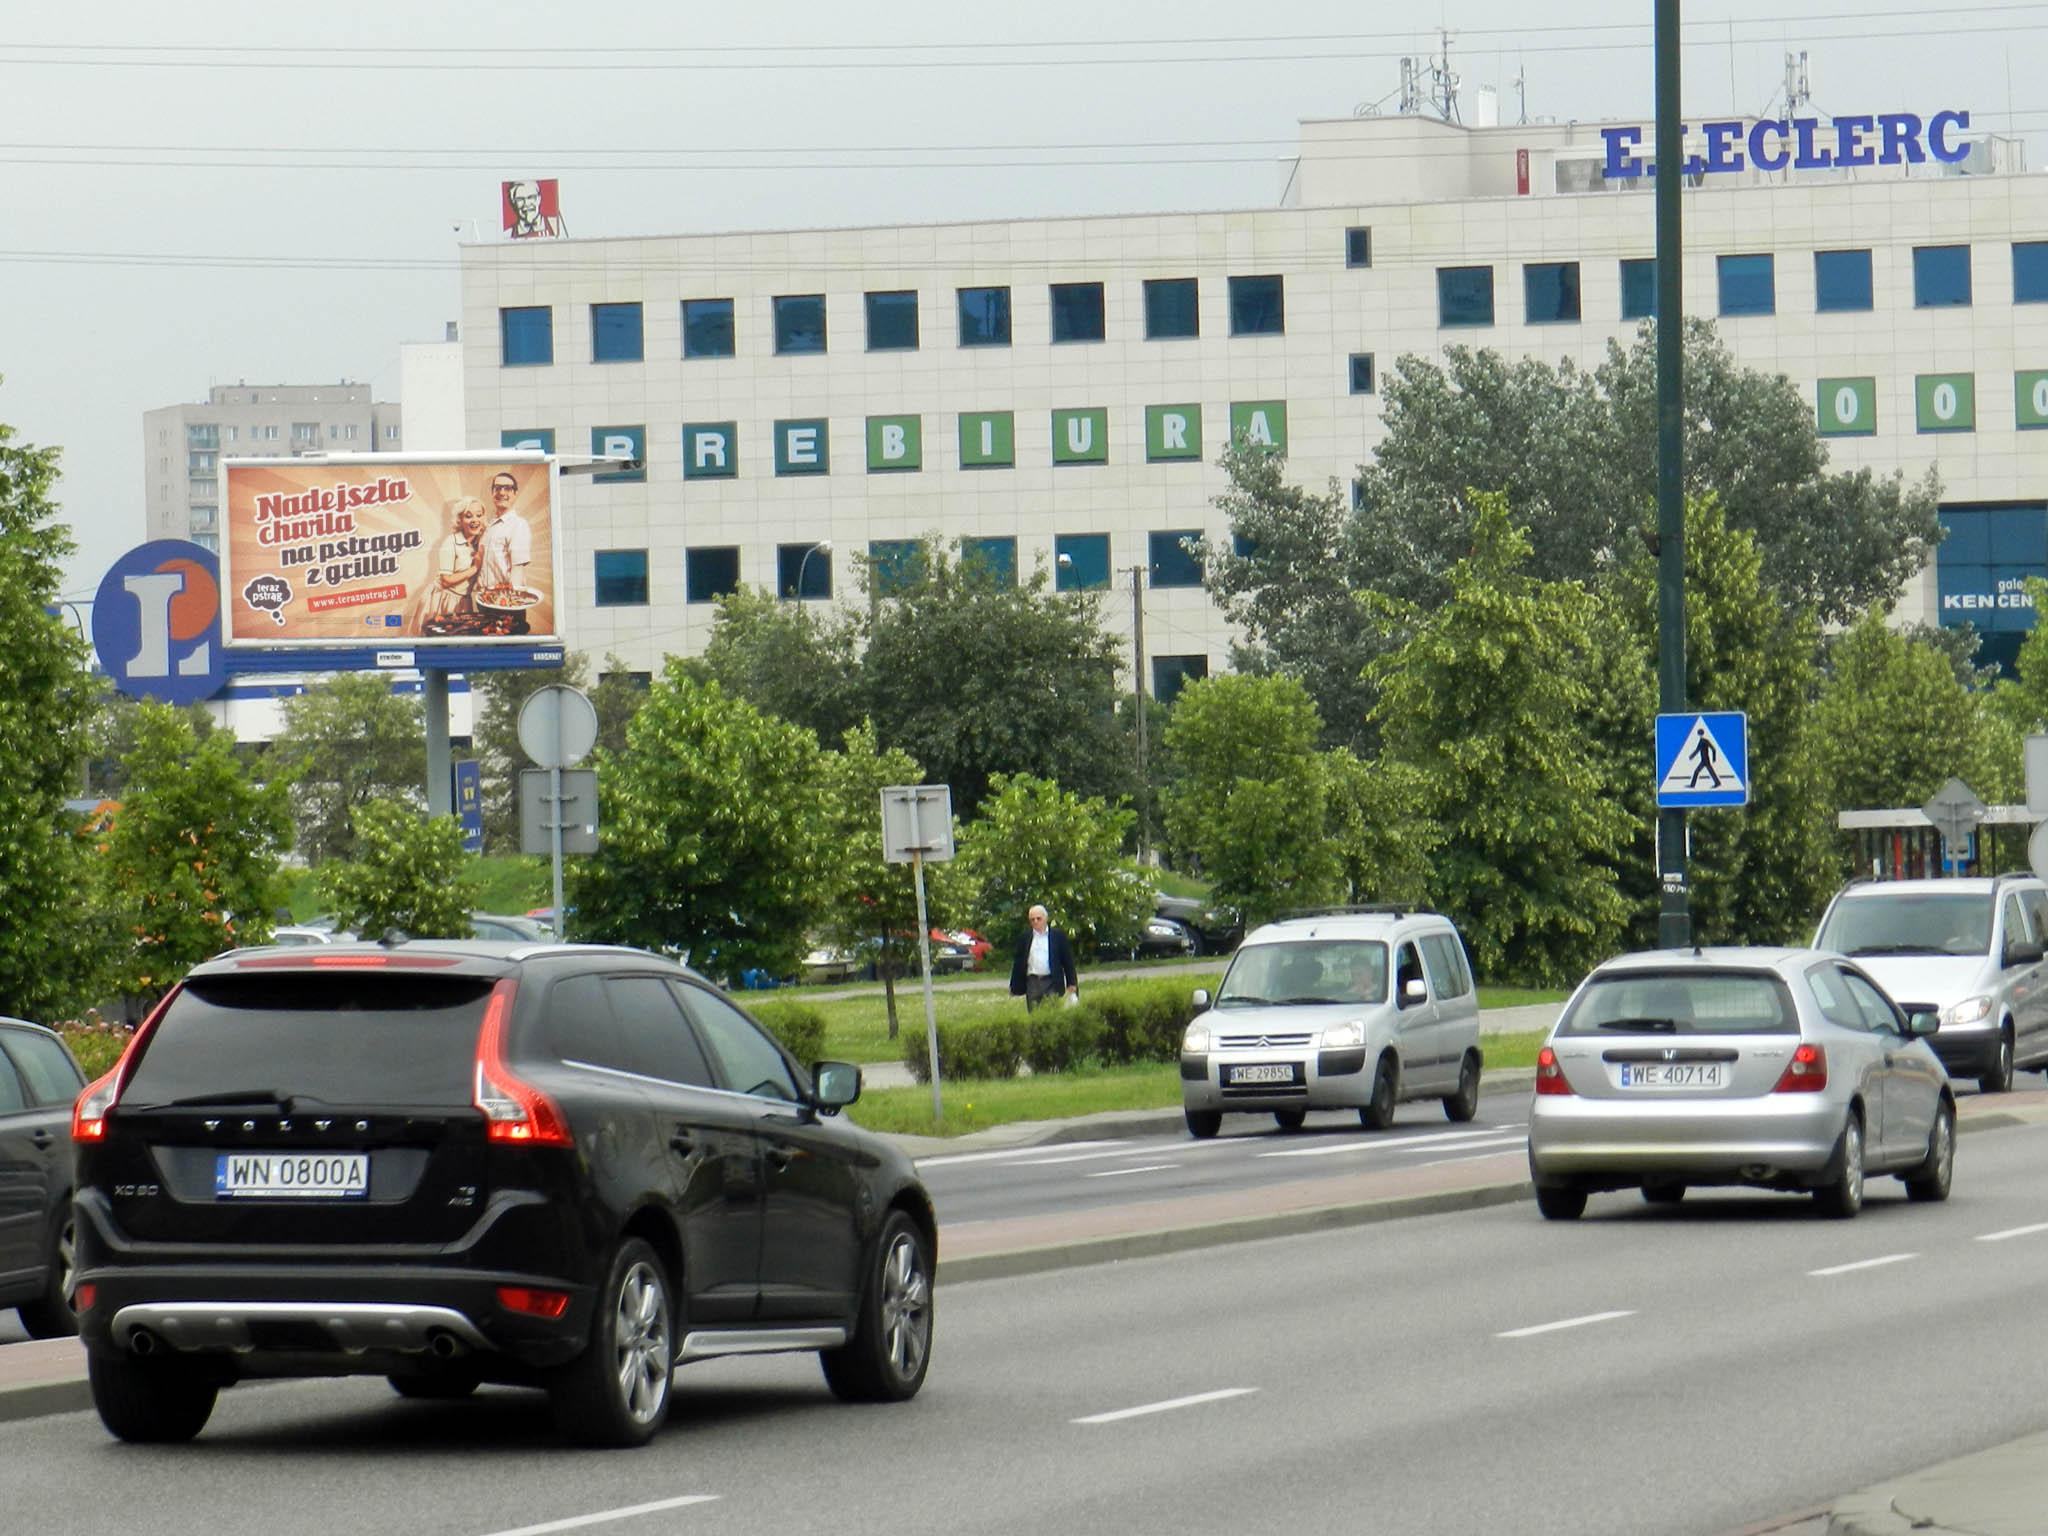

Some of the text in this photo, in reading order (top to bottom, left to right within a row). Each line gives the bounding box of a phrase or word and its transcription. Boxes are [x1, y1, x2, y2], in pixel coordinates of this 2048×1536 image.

[514, 410, 1273, 468] BRE BIURA
[256, 478, 410, 521] Nadejszła
[259, 513, 355, 545] chwila
[281, 545, 316, 566] na
[307, 556, 399, 585] z grilla
[257, 584, 280, 593] teraz
[1944, 594, 2033, 608] KEN CEN
[1236, 1067, 1254, 1080] WE
[1633, 1066, 1718, 1083] WE 40714
[204, 1119, 368, 1131] VOLVO
[233, 1159, 362, 1185] WN 0800A
